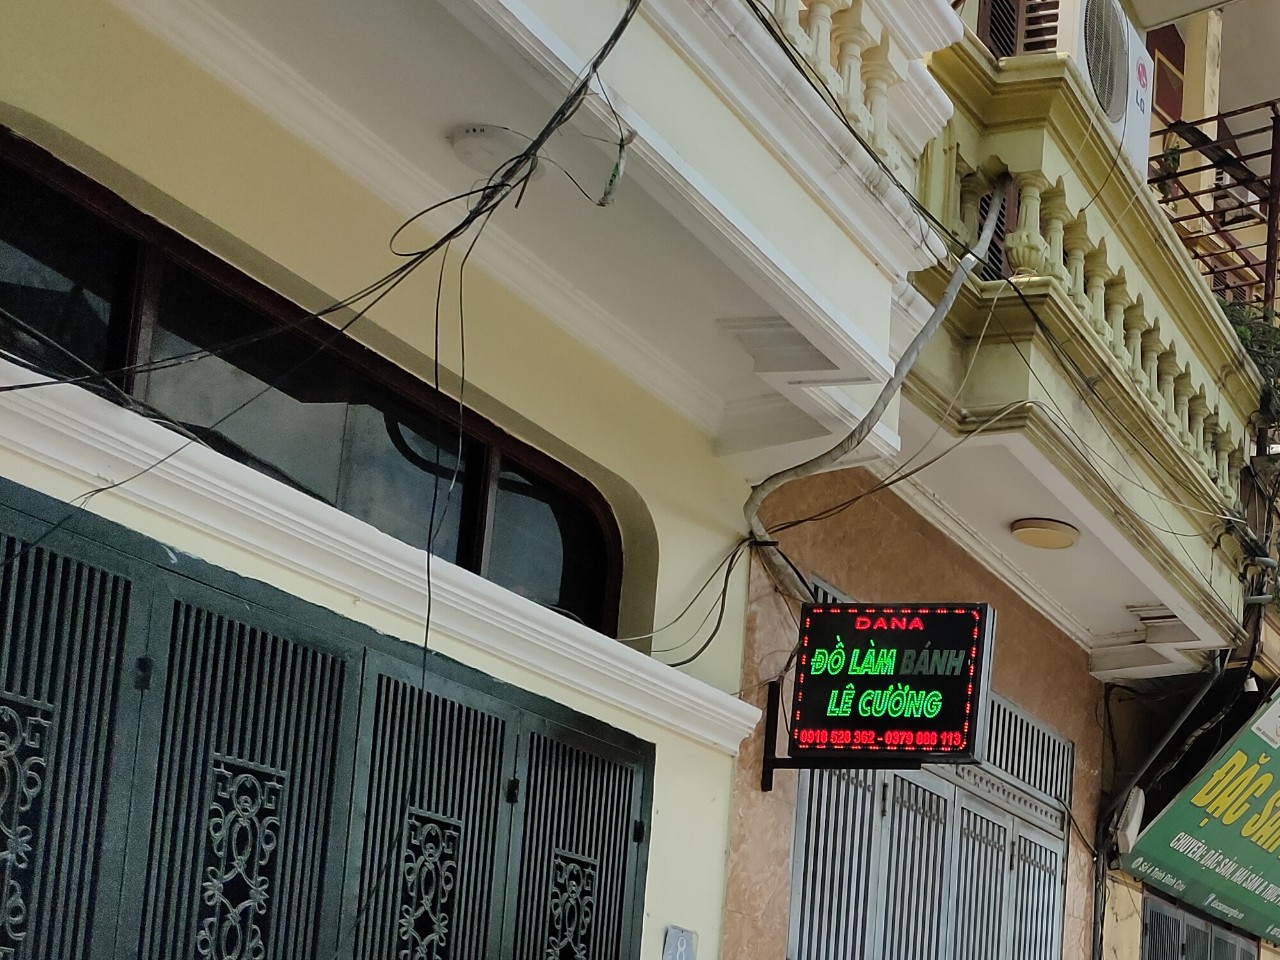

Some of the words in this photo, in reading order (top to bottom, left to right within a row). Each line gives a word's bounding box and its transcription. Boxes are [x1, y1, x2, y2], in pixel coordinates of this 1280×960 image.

[1135, 90, 1145, 115] LG
[855, 616, 925, 631] DANA
[810, 636, 846, 676] ĐỒ
[847, 640, 897, 676] LÀM
[899, 641, 966, 676] BÁNH
[826, 685, 856, 717] LÊ
[858, 682, 943, 718] CƯỜNG
[854, 730, 875, 744] 362
[1190, 749, 1274, 827] ĐẶC
[1200, 849, 1223, 870] ĐẶC
